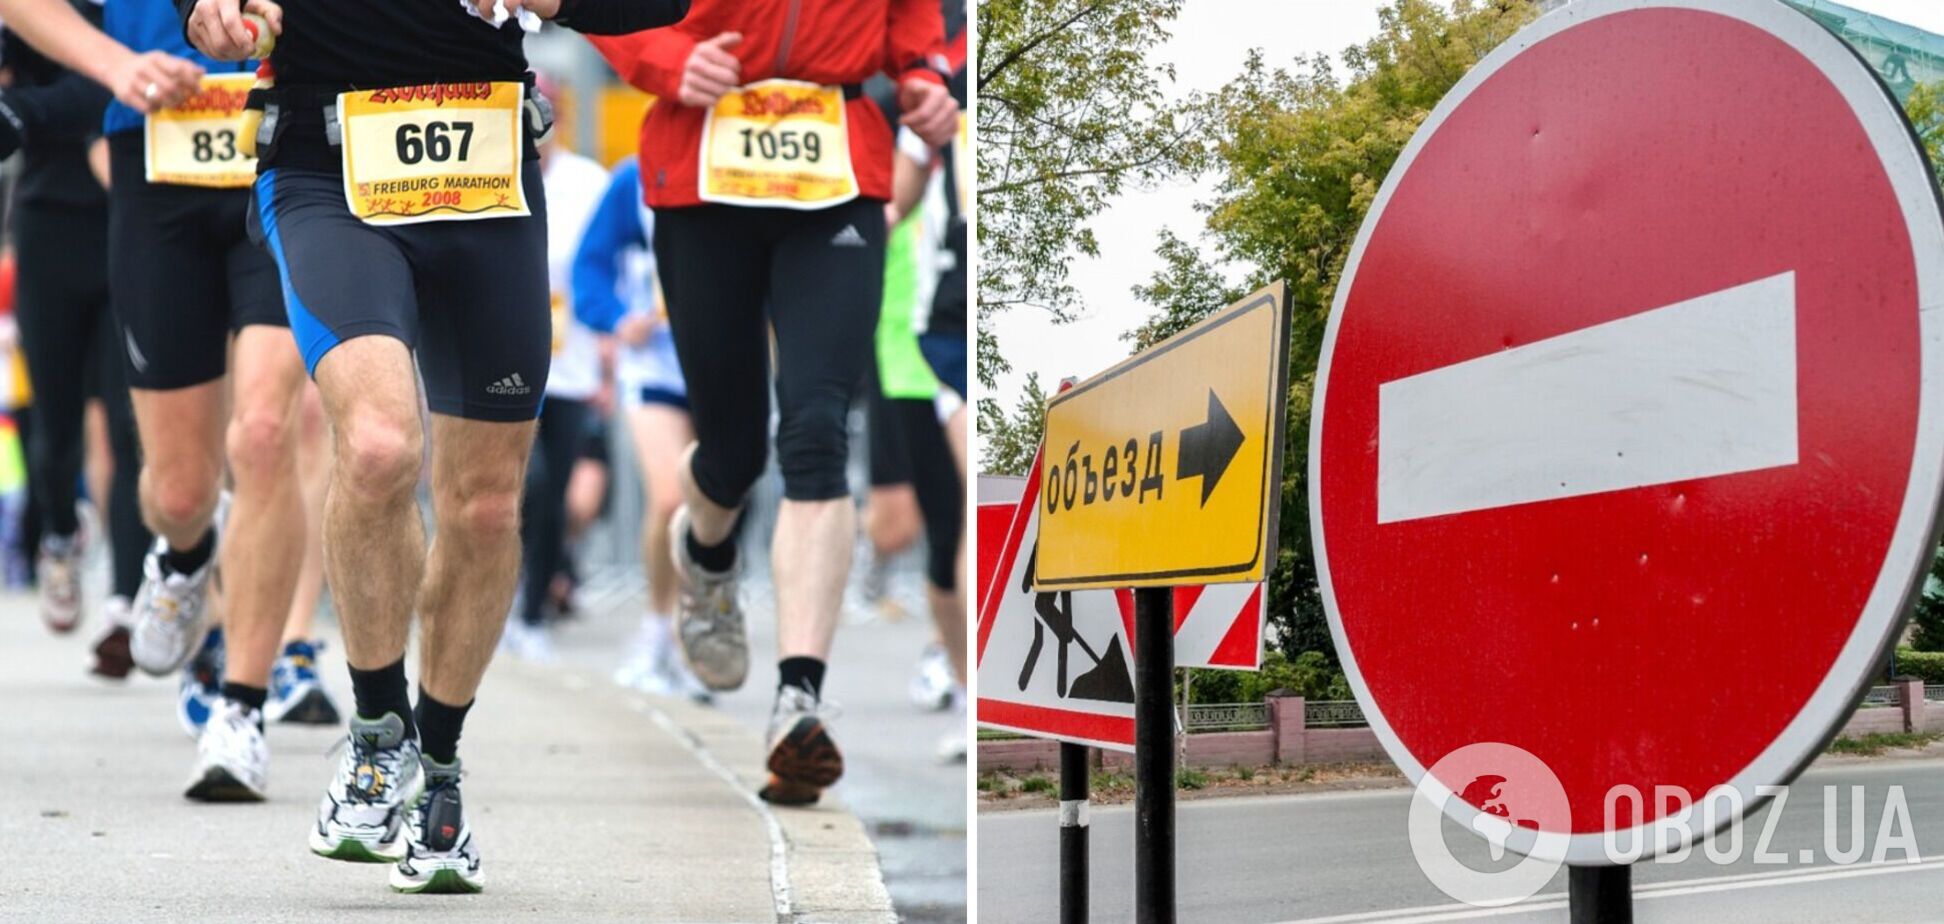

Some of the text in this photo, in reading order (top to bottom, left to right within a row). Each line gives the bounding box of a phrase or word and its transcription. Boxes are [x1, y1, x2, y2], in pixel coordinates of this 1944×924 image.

[192, 128, 253, 162] 83
[395, 121, 474, 165] 667
[739, 127, 821, 163] 1059
[373, 177, 439, 195] FREIBURG
[444, 176, 511, 189] MARATHON
[421, 191, 462, 207] 2008
[1047, 430, 1164, 515] объезд
